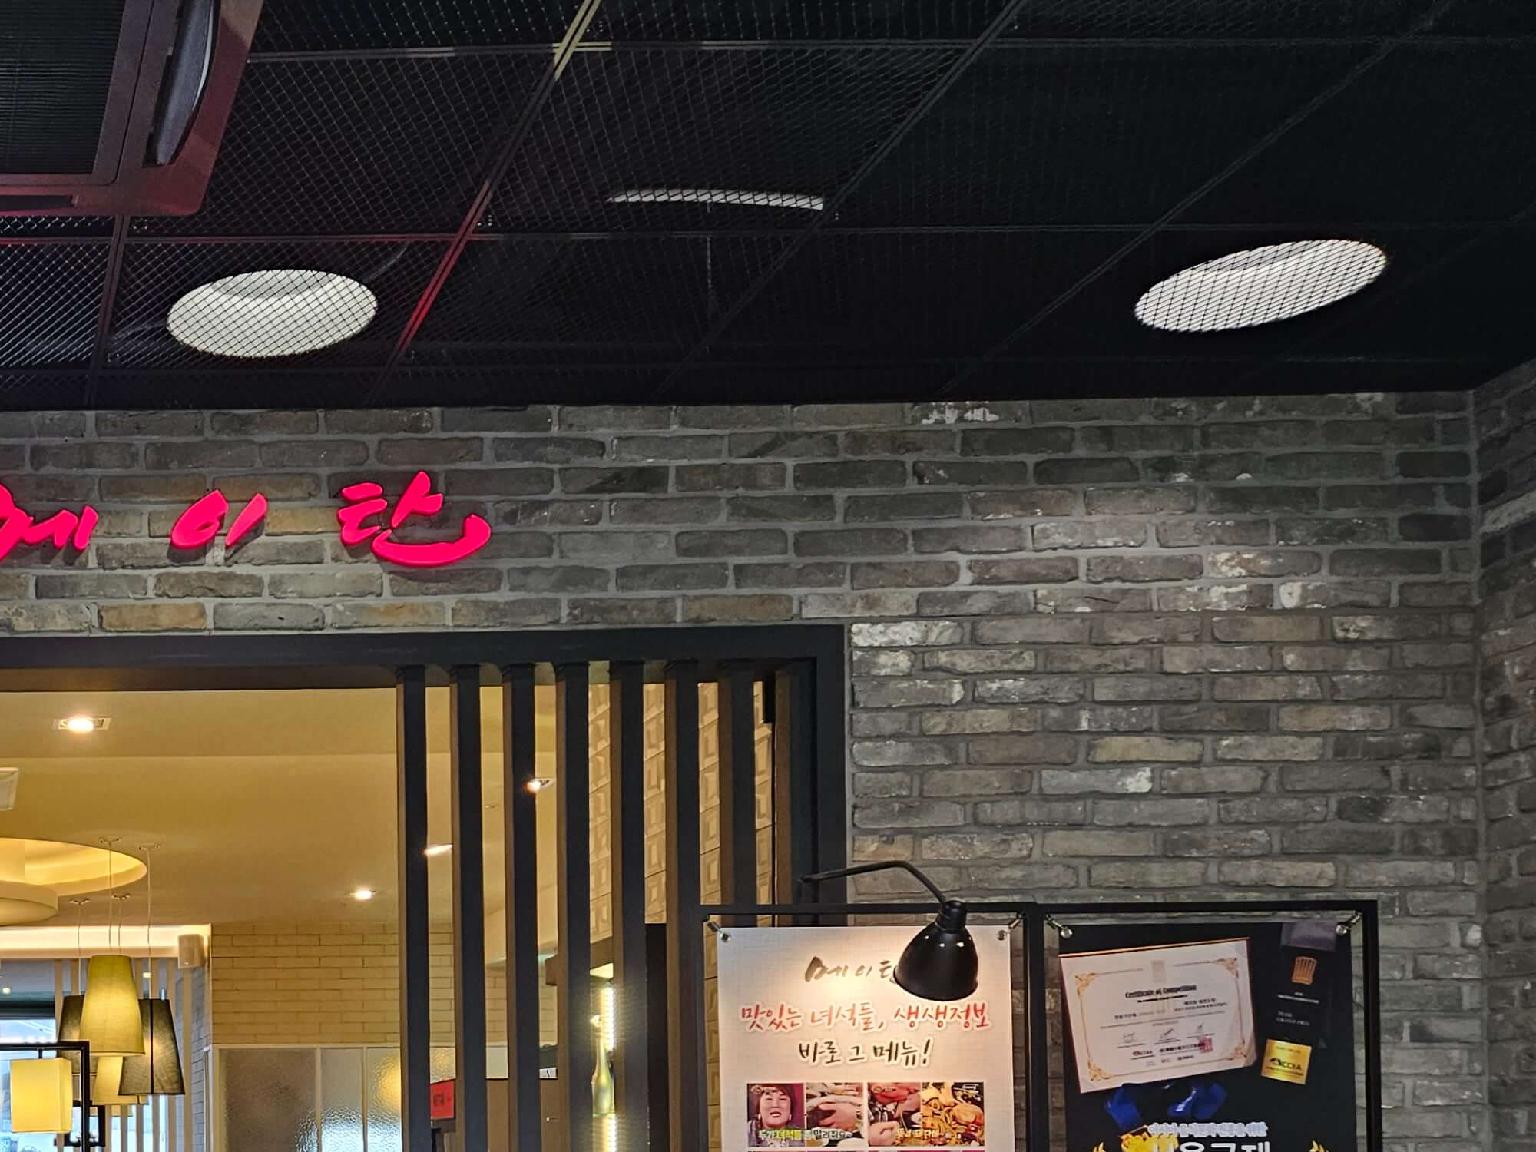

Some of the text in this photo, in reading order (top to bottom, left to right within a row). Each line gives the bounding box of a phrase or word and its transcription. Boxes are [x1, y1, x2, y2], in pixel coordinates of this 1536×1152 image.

[742, 1002, 990, 1031] 맛있는 녀석들, 생생정보
[799, 1039, 932, 1067] 바로 그 메뉴!
